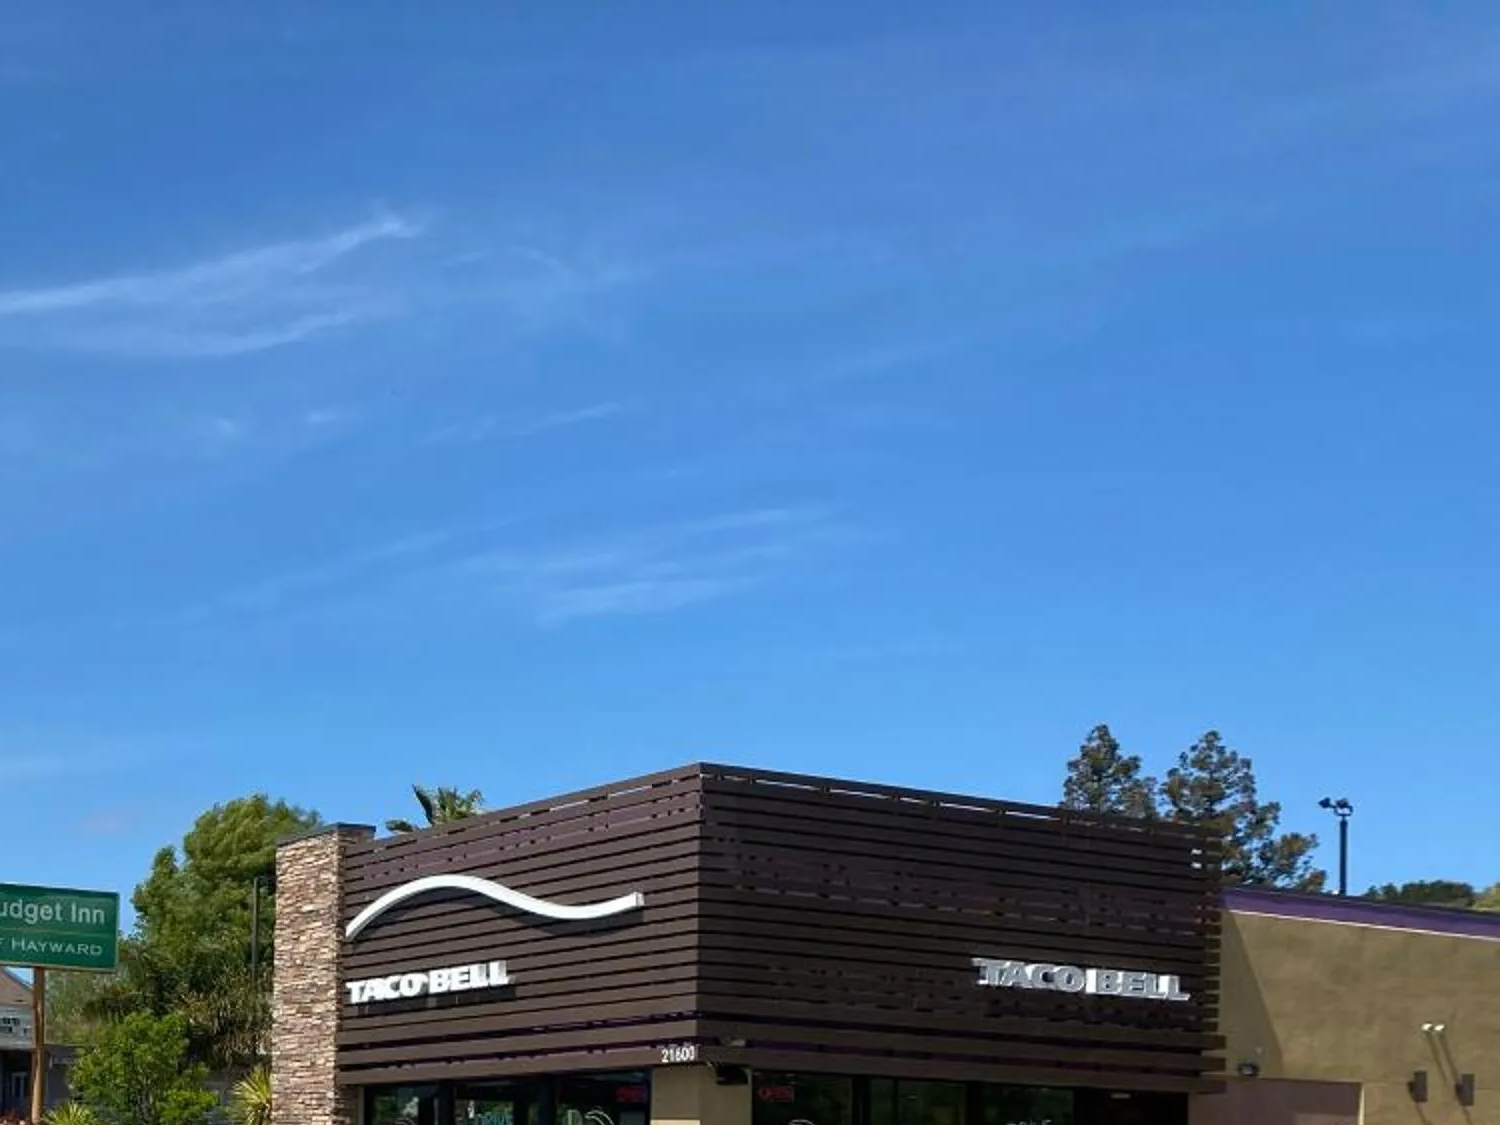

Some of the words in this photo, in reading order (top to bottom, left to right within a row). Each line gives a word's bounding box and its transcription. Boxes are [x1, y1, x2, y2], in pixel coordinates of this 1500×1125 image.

[70, 901, 105, 925] Inn
[11, 937, 103, 957] HAYWARD
[346, 973, 428, 1004] TACO
[428, 959, 516, 994] BELL
[972, 957, 1085, 993] TACO
[1085, 968, 1191, 1001] BELL
